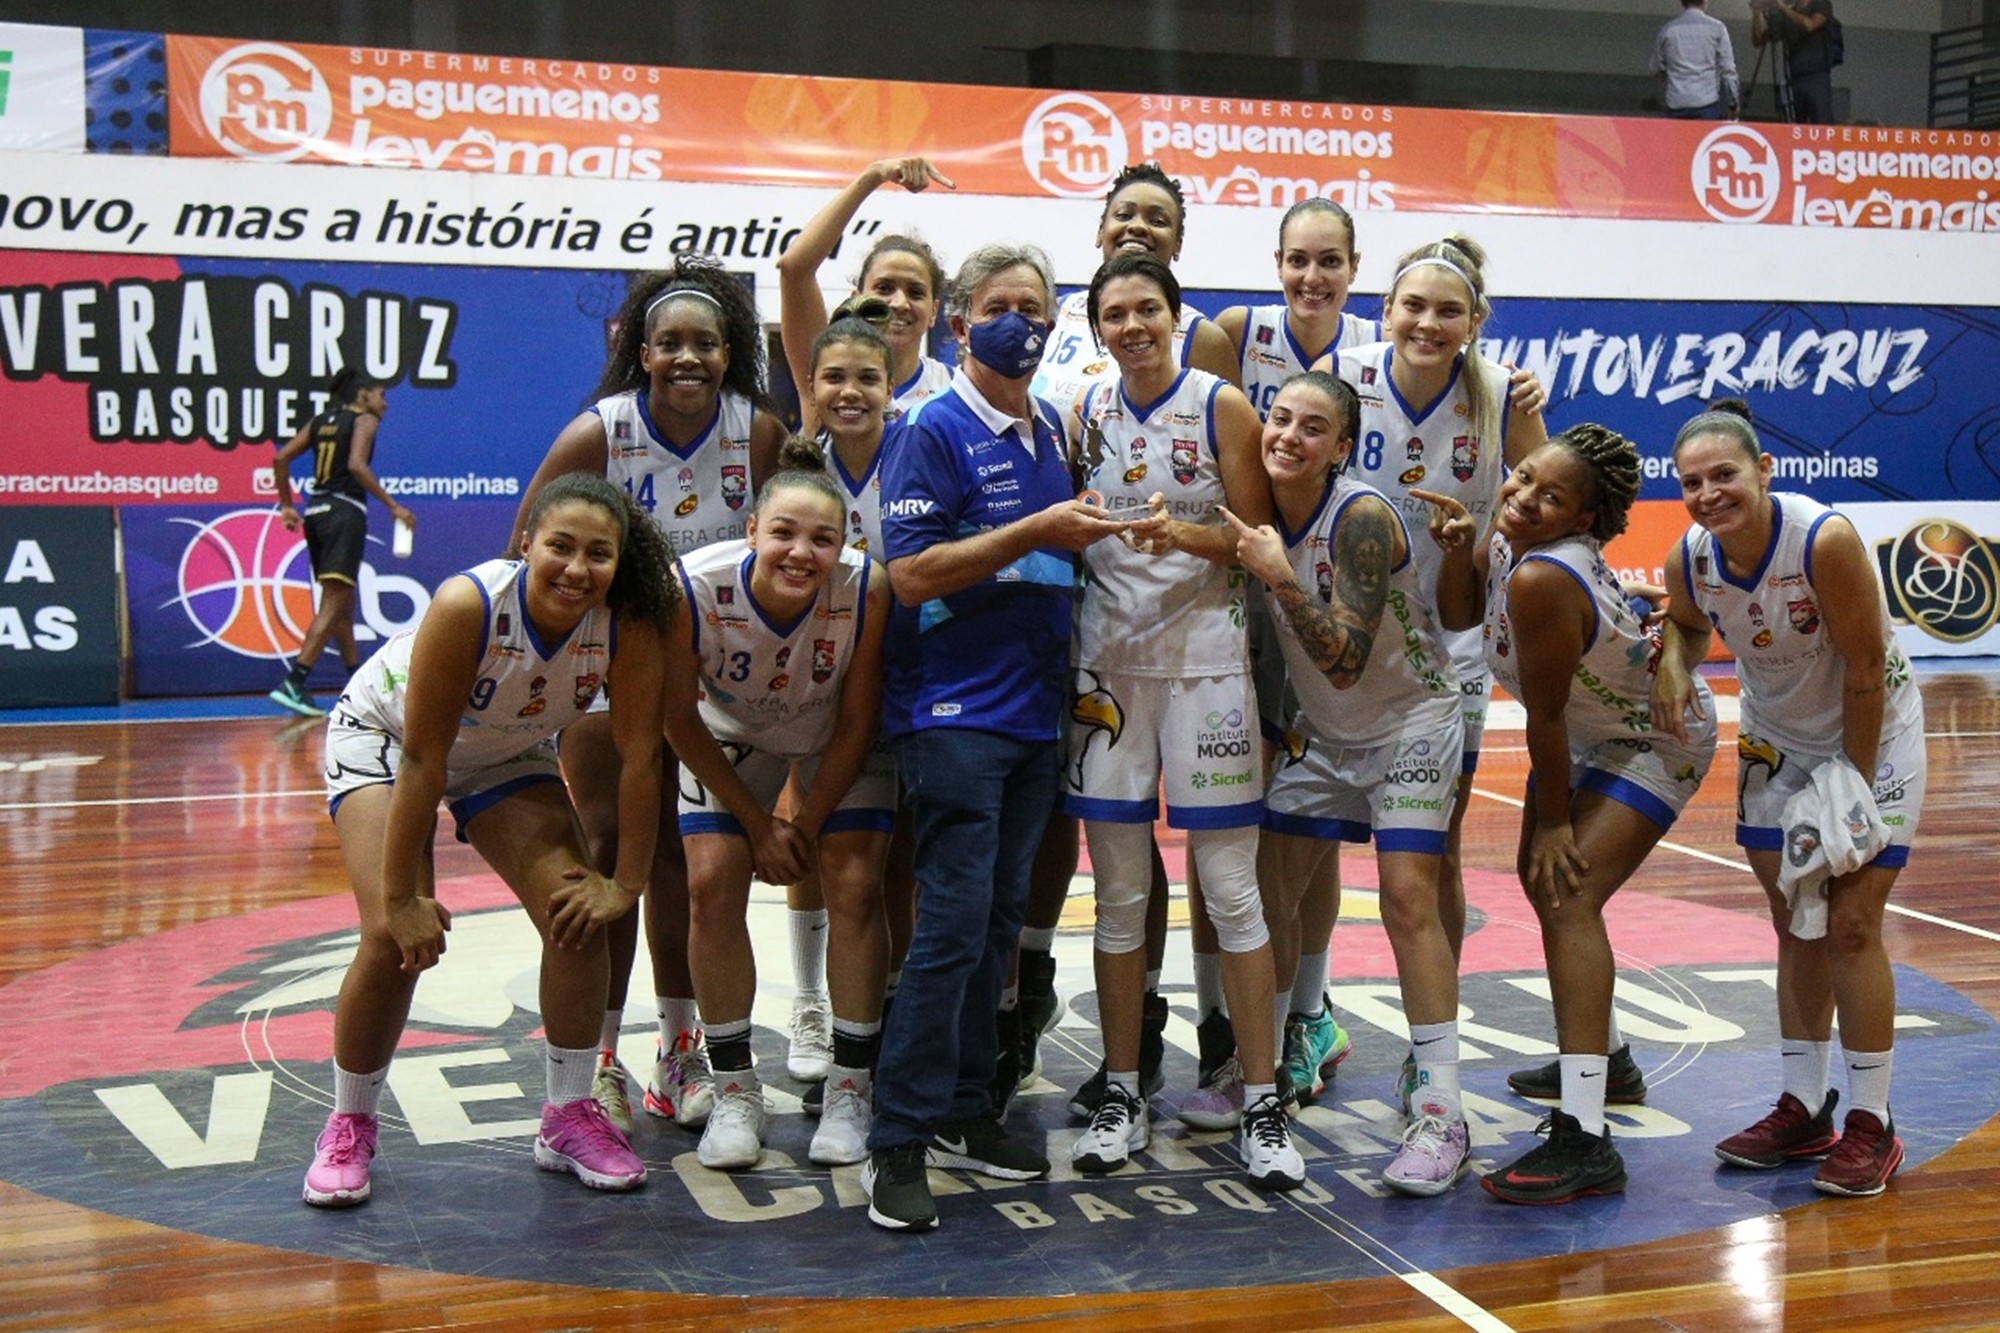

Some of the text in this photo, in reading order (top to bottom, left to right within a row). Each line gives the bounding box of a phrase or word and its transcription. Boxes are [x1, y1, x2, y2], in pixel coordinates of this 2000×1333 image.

[350, 48, 661, 83] SUPERMERCADOS
[350, 75, 661, 123] paguemenos
[1141, 97, 1393, 123] SUPERMERCADOS
[1142, 120, 1393, 159] paguemenos
[1793, 127, 2000, 147] SUPERMERCADO
[0, 194, 149, 245] ovo,
[174, 202, 308, 242] mas
[325, 205, 361, 243] a
[376, 199, 600, 253] história
[620, 207, 654, 254] é
[1, 280, 452, 381] VERA CRUZ
[97, 387, 330, 443] BASQUET
[1363, 430, 1385, 472] 8
[890, 499, 934, 516] MRV
[669, 529, 708, 545] ERA
[4, 540, 55, 583] A
[469, 677, 498, 711] 9
[1197, 740, 1251, 759] MOOD
[1385, 768, 1441, 784] MOOD
[1397, 796, 1442, 812] Sicredi
